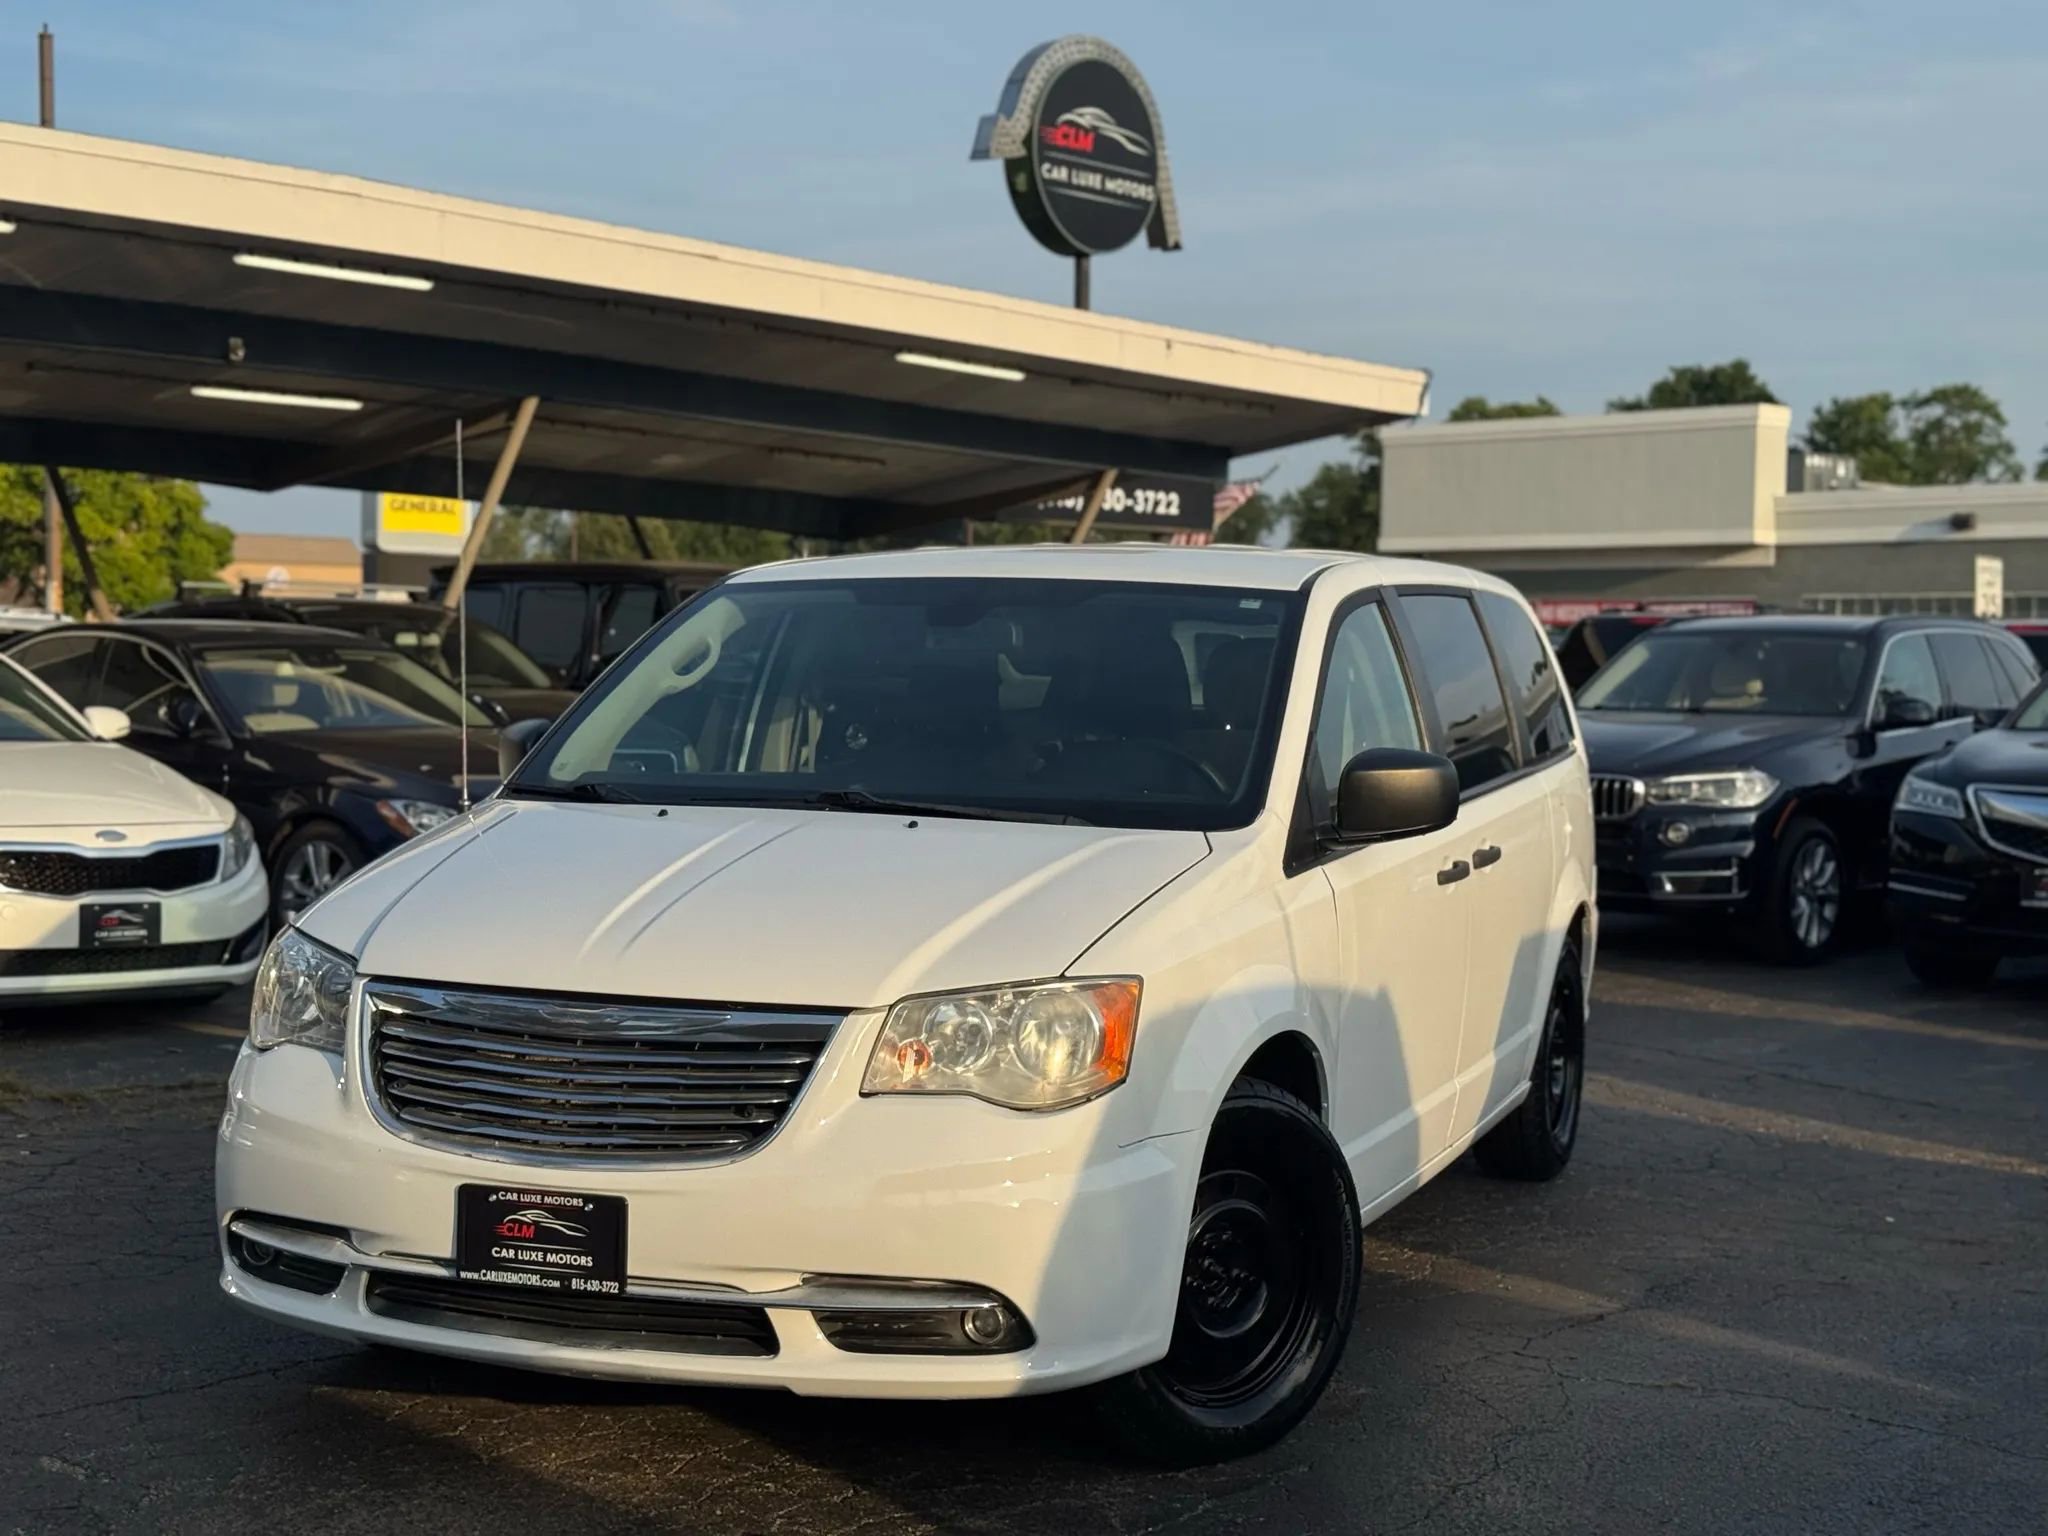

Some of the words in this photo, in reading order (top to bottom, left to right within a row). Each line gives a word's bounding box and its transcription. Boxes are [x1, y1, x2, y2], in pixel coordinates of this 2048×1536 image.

[1055, 122, 1095, 153] CLM
[1041, 162, 1069, 183] CAR
[1071, 168, 1103, 190] LUXE
[1104, 177, 1155, 201] MOTORS
[390, 497, 456, 515] GENERAL
[498, 1191, 518, 1201] CAR
[520, 1194, 542, 1204] LUXE
[544, 1195, 584, 1207] MOTORS
[503, 1222, 536, 1239] CLM
[491, 1247, 516, 1259] CAR
[518, 1250, 544, 1262] LUXE
[546, 1252, 593, 1267] MOTORS
[571, 1278, 619, 1293] 815-630-3722
